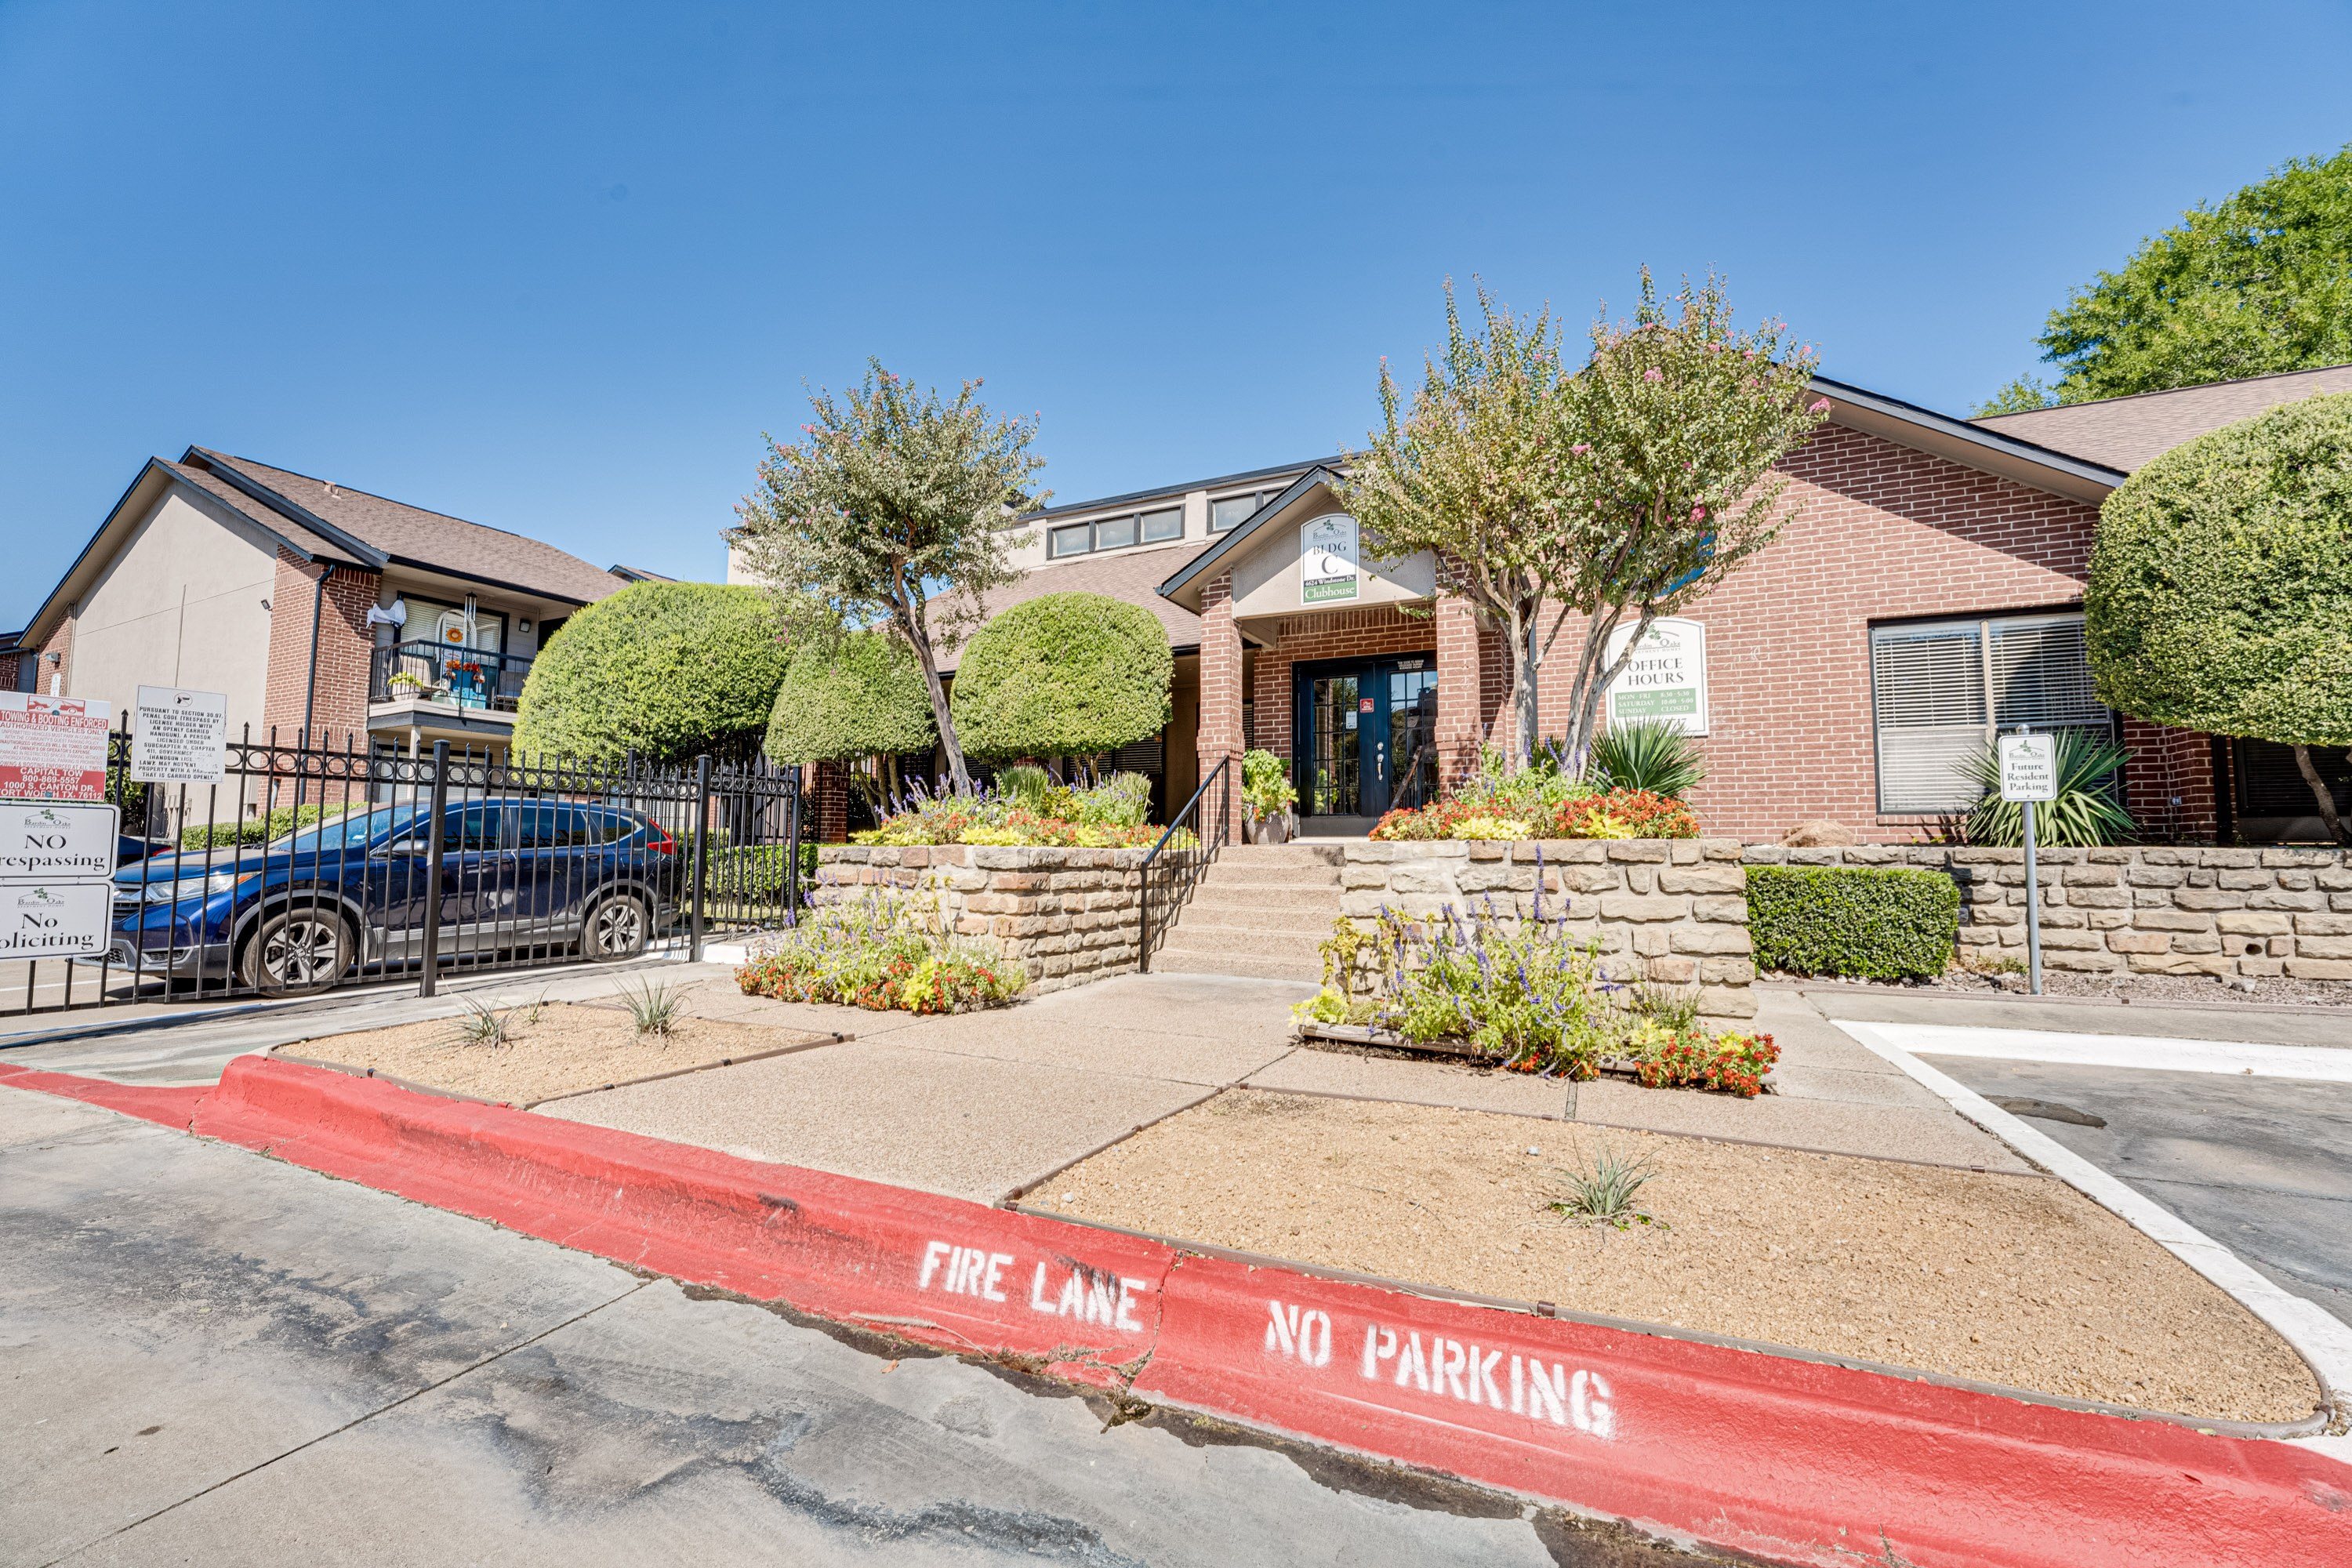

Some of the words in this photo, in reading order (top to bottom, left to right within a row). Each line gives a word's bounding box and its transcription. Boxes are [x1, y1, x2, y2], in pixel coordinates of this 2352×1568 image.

[1313, 541, 1347, 555] BLDG
[1321, 555, 1338, 575] C
[1305, 586, 1355, 598] Clubhouse
[1660, 638, 1681, 647] Oaks
[1628, 659, 1683, 672] OFFICE
[1628, 672, 1683, 685] HOURS
[2, 710, 29, 723] TOWING
[31, 713, 37, 724] &
[38, 714, 69, 726] BOOTING
[71, 717, 107, 729] ENFORCED
[0, 722, 49, 731] AUTHORIZED
[22, 775, 80, 784] 800-869-5557
[2007, 771, 2049, 780] Resident
[2009, 782, 2049, 793] Parking
[25, 834, 67, 849] NO
[0, 853, 106, 872] respassing
[21, 913, 58, 928] No
[0, 932, 94, 950] oliciting
[919, 1240, 1014, 1303] FIRE
[1031, 1263, 1146, 1331] LANE
[1264, 1299, 1331, 1367] NO
[1363, 1323, 1617, 1438] PARKING
